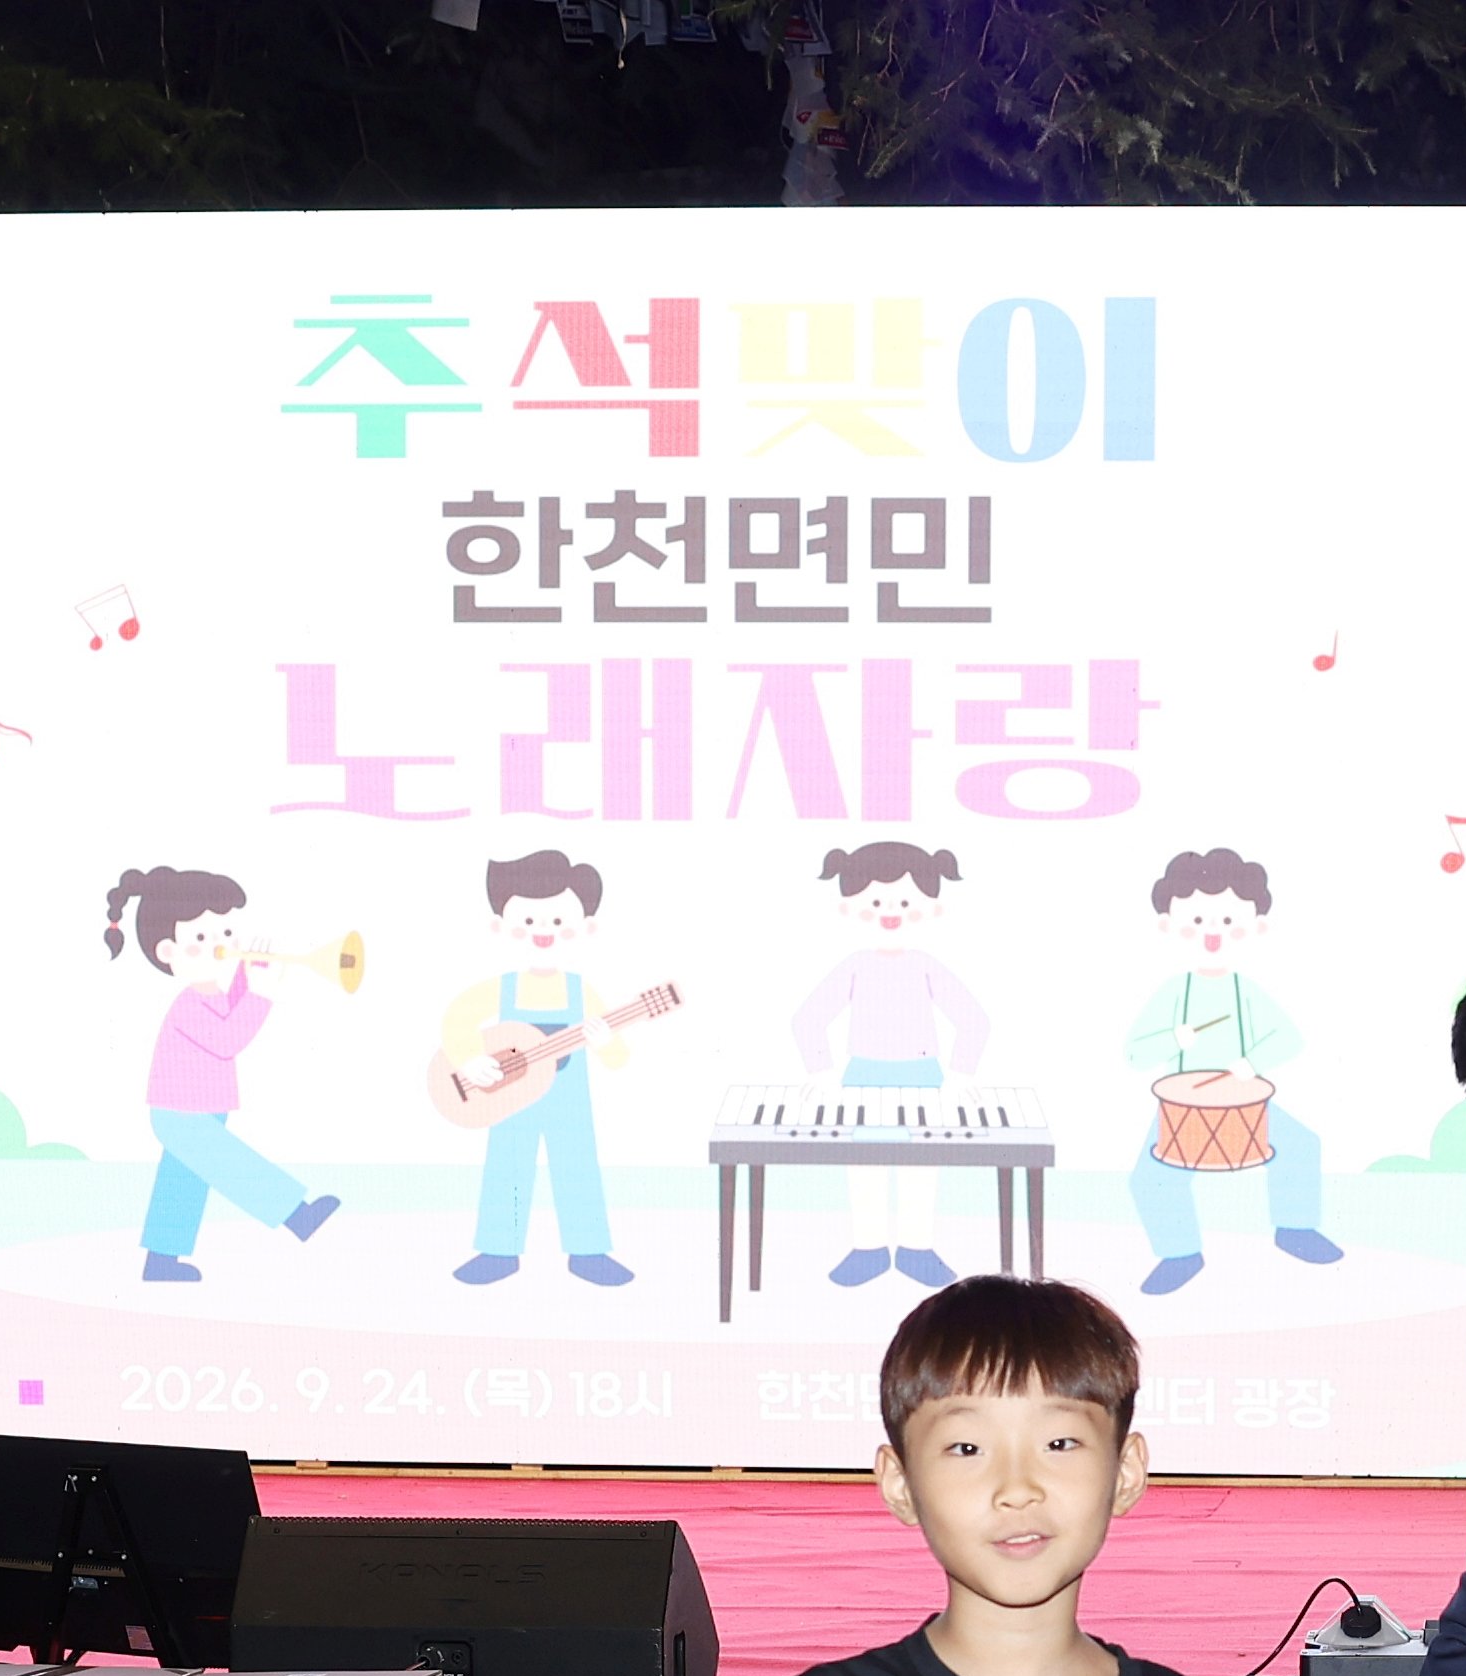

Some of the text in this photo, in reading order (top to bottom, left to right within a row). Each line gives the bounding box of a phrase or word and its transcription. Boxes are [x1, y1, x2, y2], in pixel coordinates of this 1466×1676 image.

[280, 294, 1157, 462] 추석맞이
[441, 489, 993, 624] 한천면민
[269, 658, 1161, 822] 노래자랑
[118, 1364, 279, 1412] 2026.
[295, 1367, 346, 1413] 9.
[362, 1369, 446, 1414] 24.
[463, 1366, 552, 1420] (목)
[570, 1368, 673, 1419] 18시
[1232, 1377, 1337, 1429] 광장
